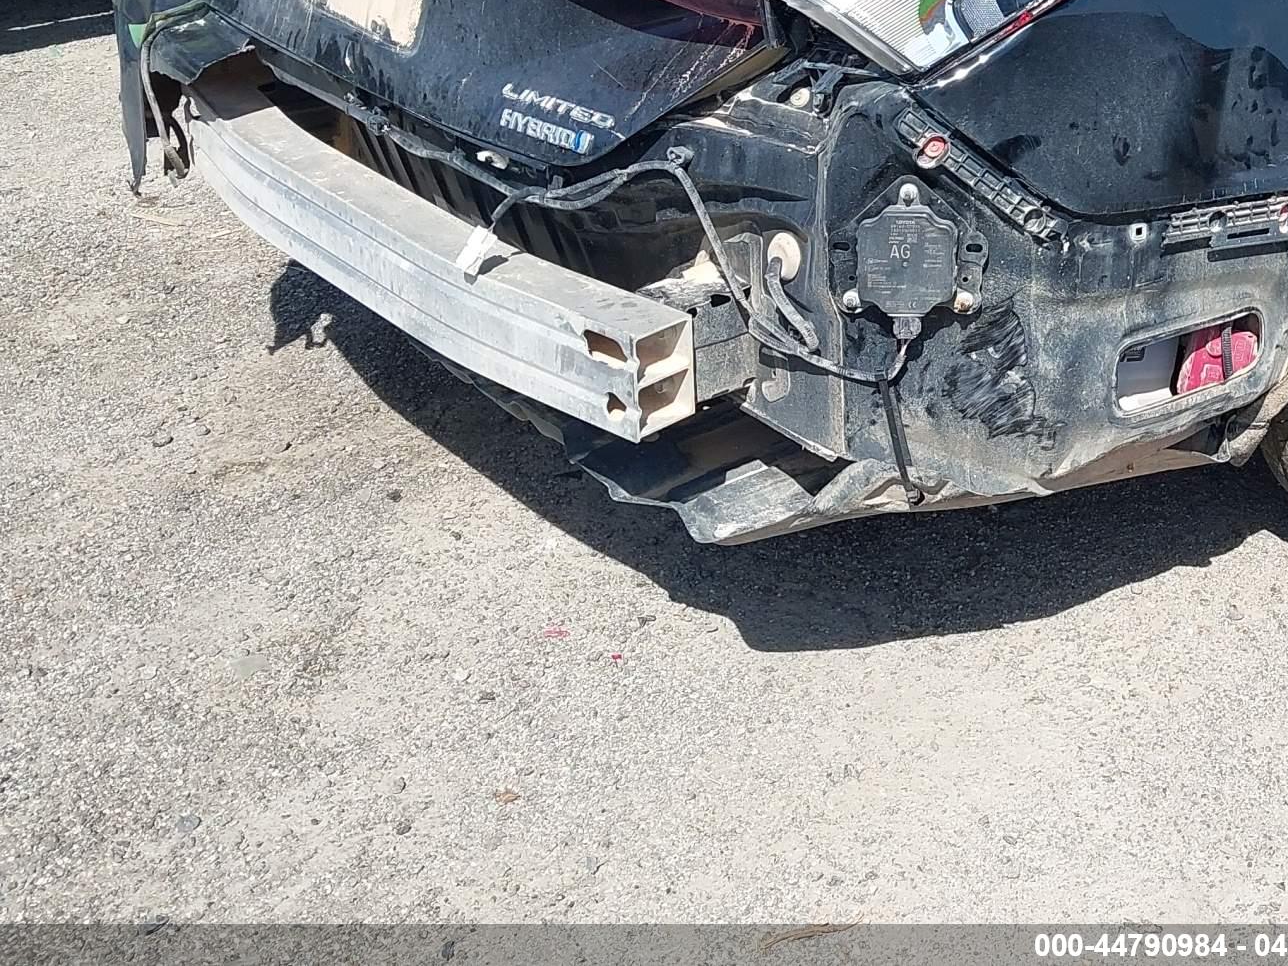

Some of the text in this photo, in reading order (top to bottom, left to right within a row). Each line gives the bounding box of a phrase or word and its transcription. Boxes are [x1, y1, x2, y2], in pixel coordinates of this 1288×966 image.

[501, 82, 616, 130] LIMITED
[499, 108, 577, 152] HYBRID
[890, 244, 911, 259] AG
